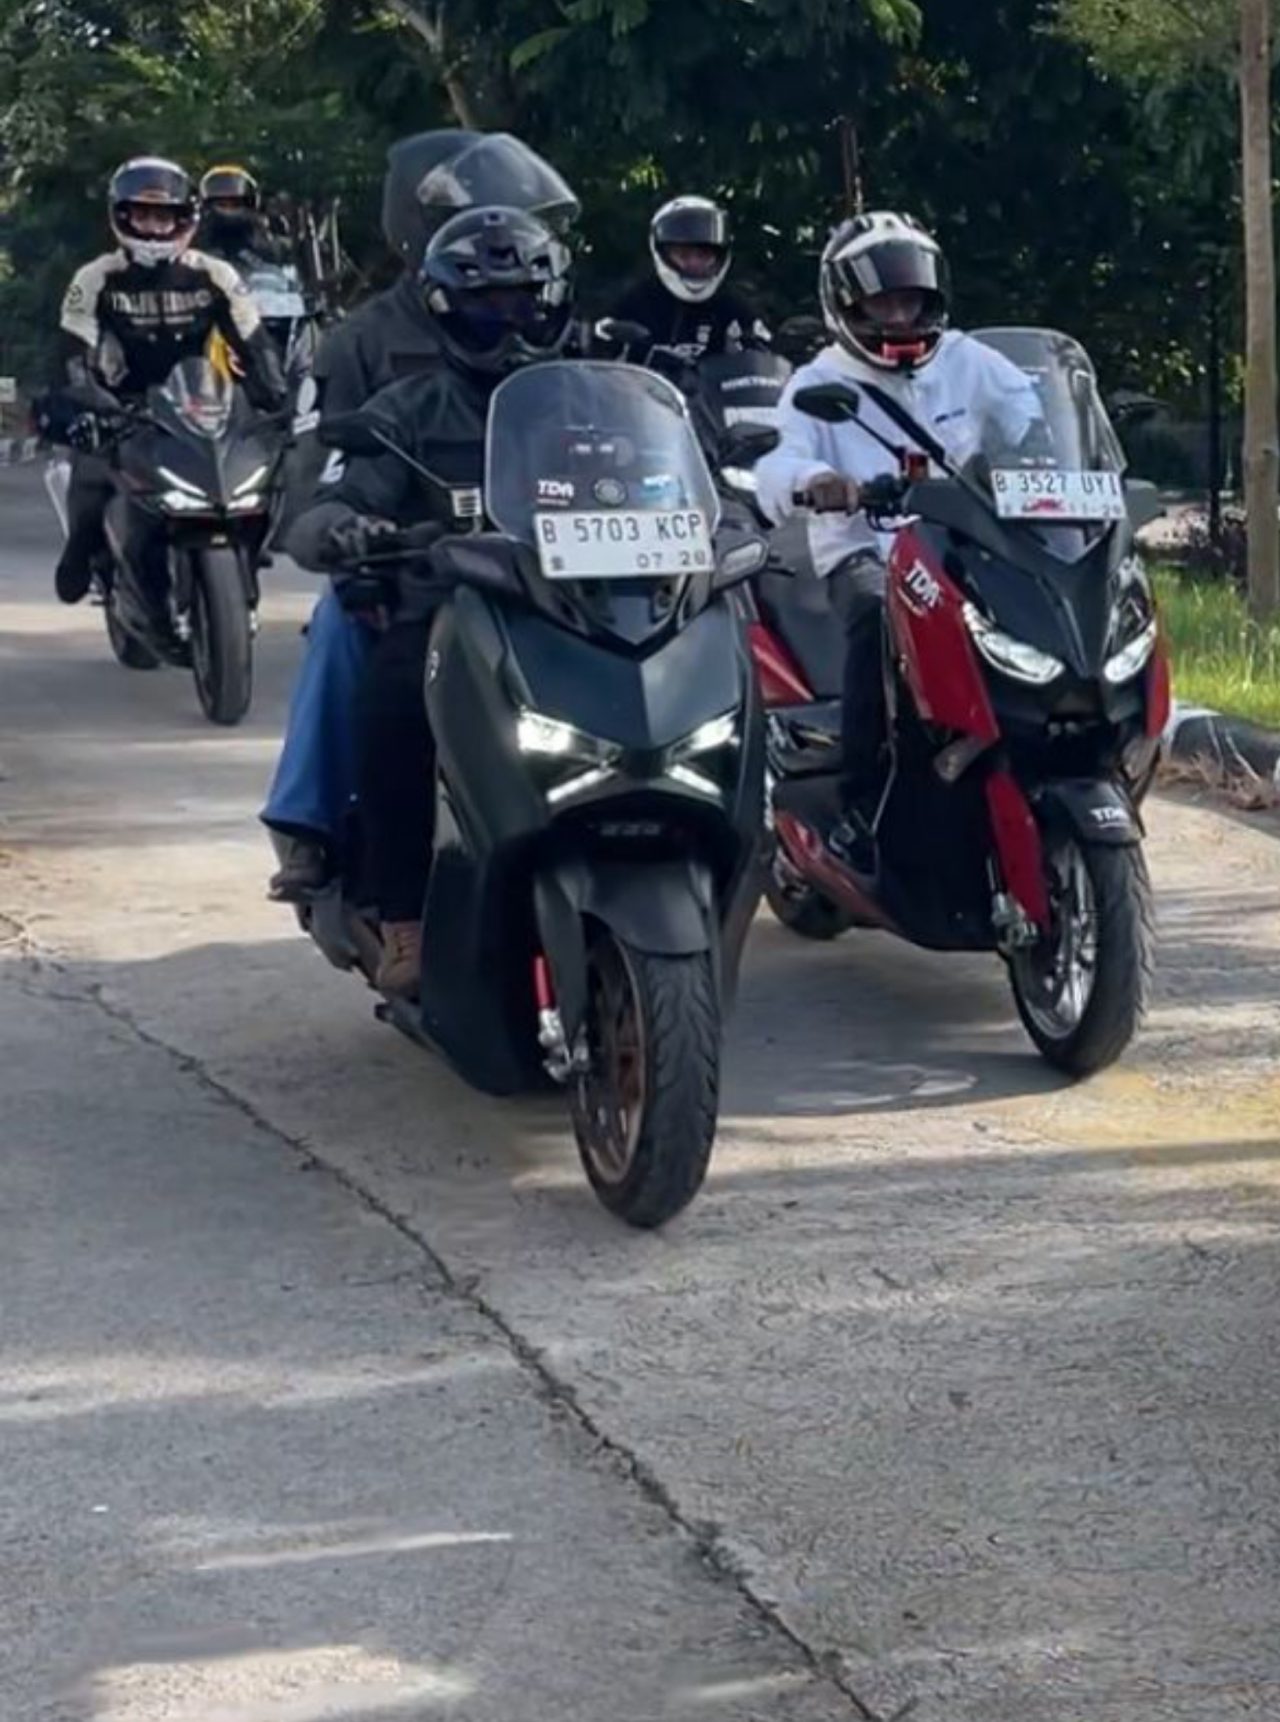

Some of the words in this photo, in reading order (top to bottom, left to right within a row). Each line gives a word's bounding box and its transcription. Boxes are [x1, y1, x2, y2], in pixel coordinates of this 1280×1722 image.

[538, 480, 575, 498] TDA
[995, 473, 1007, 492] B
[1020, 473, 1067, 493] 3527
[542, 519, 557, 543] B
[573, 517, 640, 543] 5703
[656, 513, 701, 541] KCP
[636, 552, 663, 569] 07
[905, 558, 940, 608] TDA
